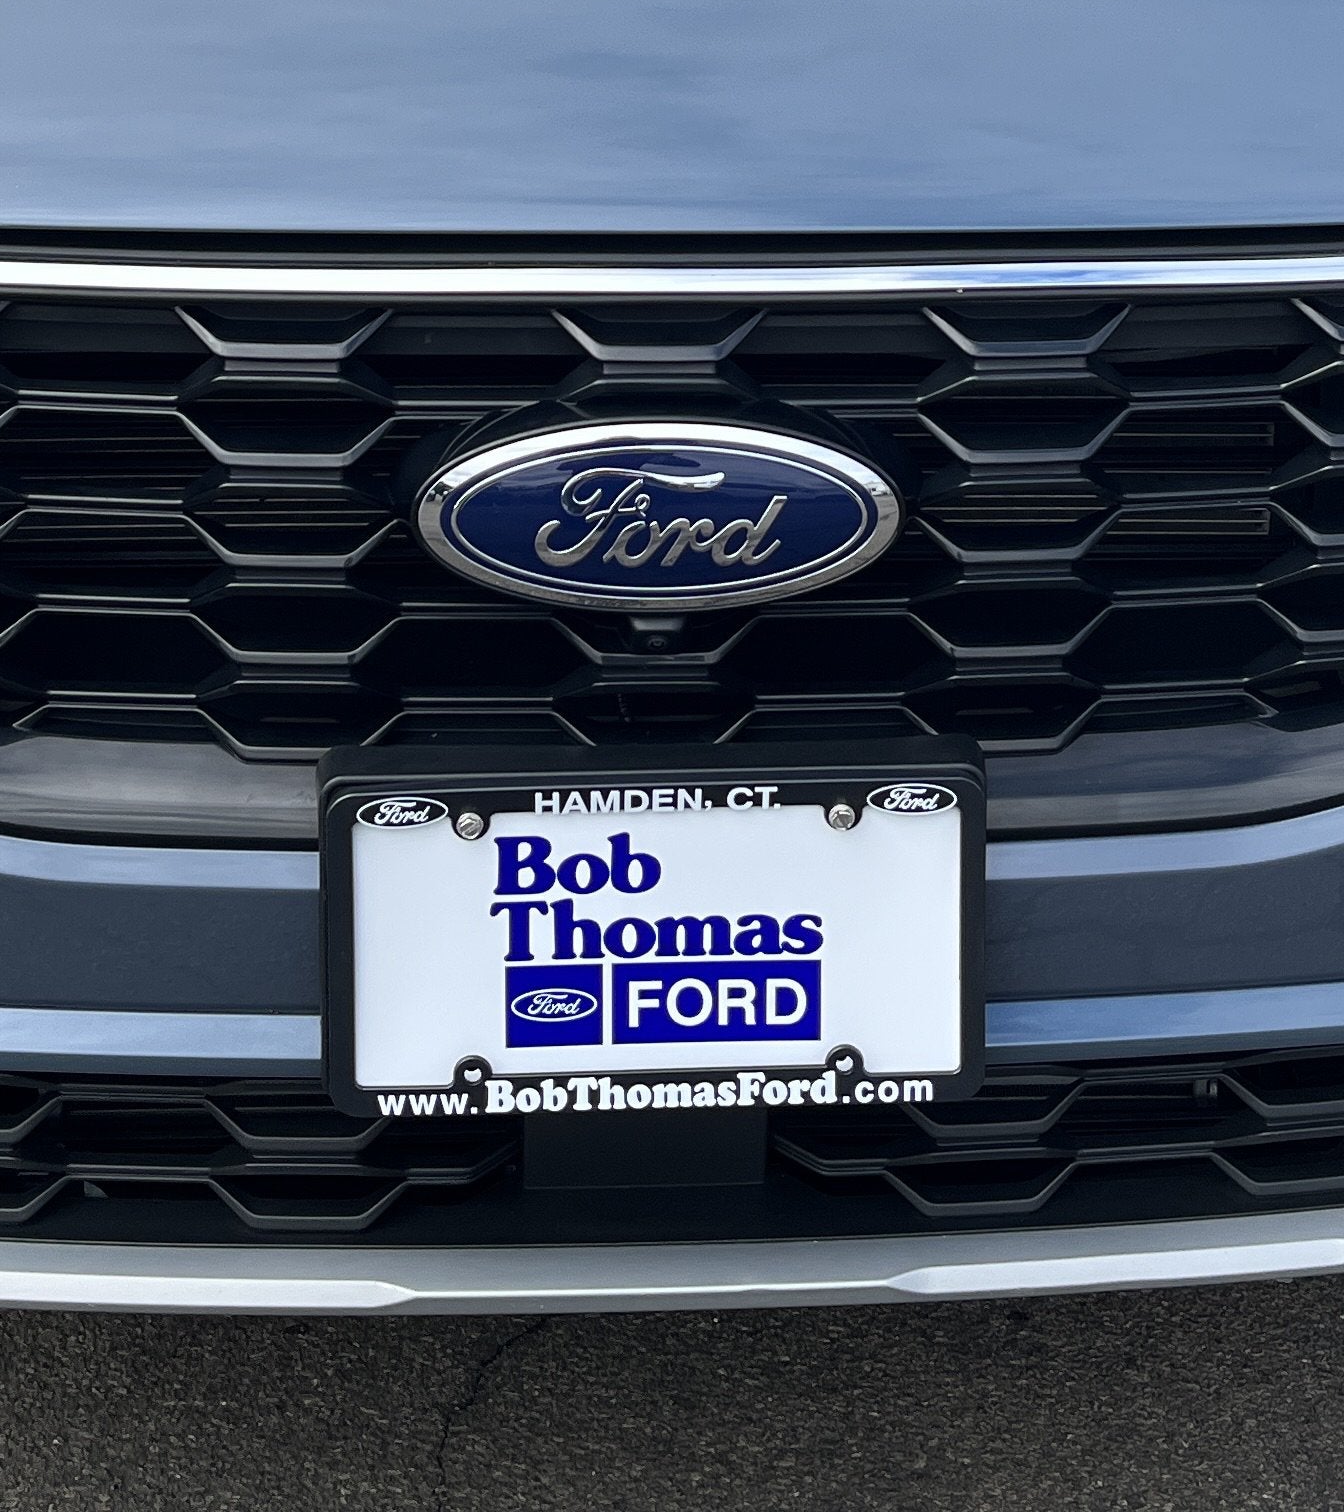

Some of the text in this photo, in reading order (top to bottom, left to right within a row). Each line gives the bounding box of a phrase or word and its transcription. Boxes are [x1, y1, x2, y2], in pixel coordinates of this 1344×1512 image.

[534, 466, 788, 569] Ford
[534, 788, 714, 817] HAMDEN,
[493, 832, 662, 895] Bob
[490, 899, 824, 962] Thomas
[526, 978, 808, 1029] Ford FORD
[378, 1070, 934, 1117] www.BobThomasFord.com
